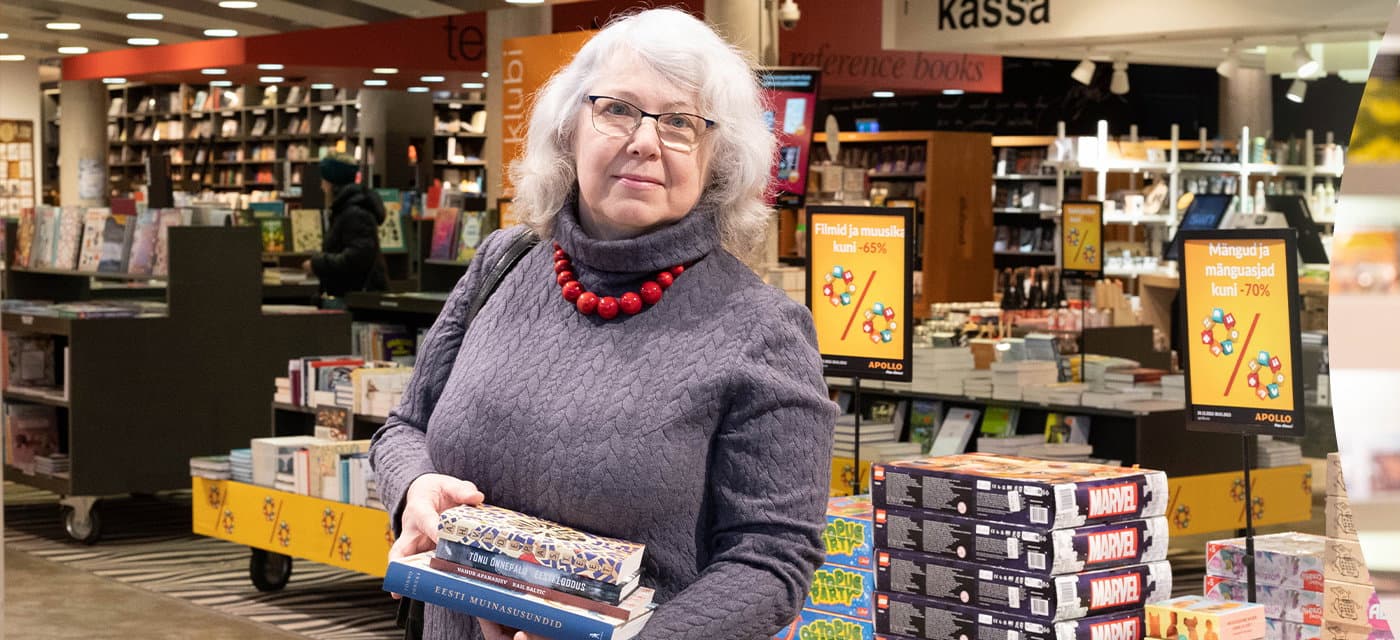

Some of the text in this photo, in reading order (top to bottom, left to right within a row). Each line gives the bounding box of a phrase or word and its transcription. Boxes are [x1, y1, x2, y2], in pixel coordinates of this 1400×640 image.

[938, 0, 1050, 30] kassa
[788, 42, 984, 83] reference books
[503, 49, 525, 144] klubi
[815, 223, 905, 238] Filmid ja muusika
[833, 240, 888, 254] kuni -65%
[1209, 242, 1270, 258] Mängud ja
[1205, 263, 1275, 279] mänguasjad
[1211, 282, 1270, 297] kuni -70%
[868, 361, 903, 370] APOLLO
[1255, 412, 1292, 424] APOLLO
[1089, 484, 1138, 517] MARVEL
[1089, 530, 1137, 563] MARVEL
[1091, 575, 1139, 608] MARVEL
[434, 585, 562, 629] EESTI MUINASUSUNDID
[1091, 619, 1139, 640] MARVEL
